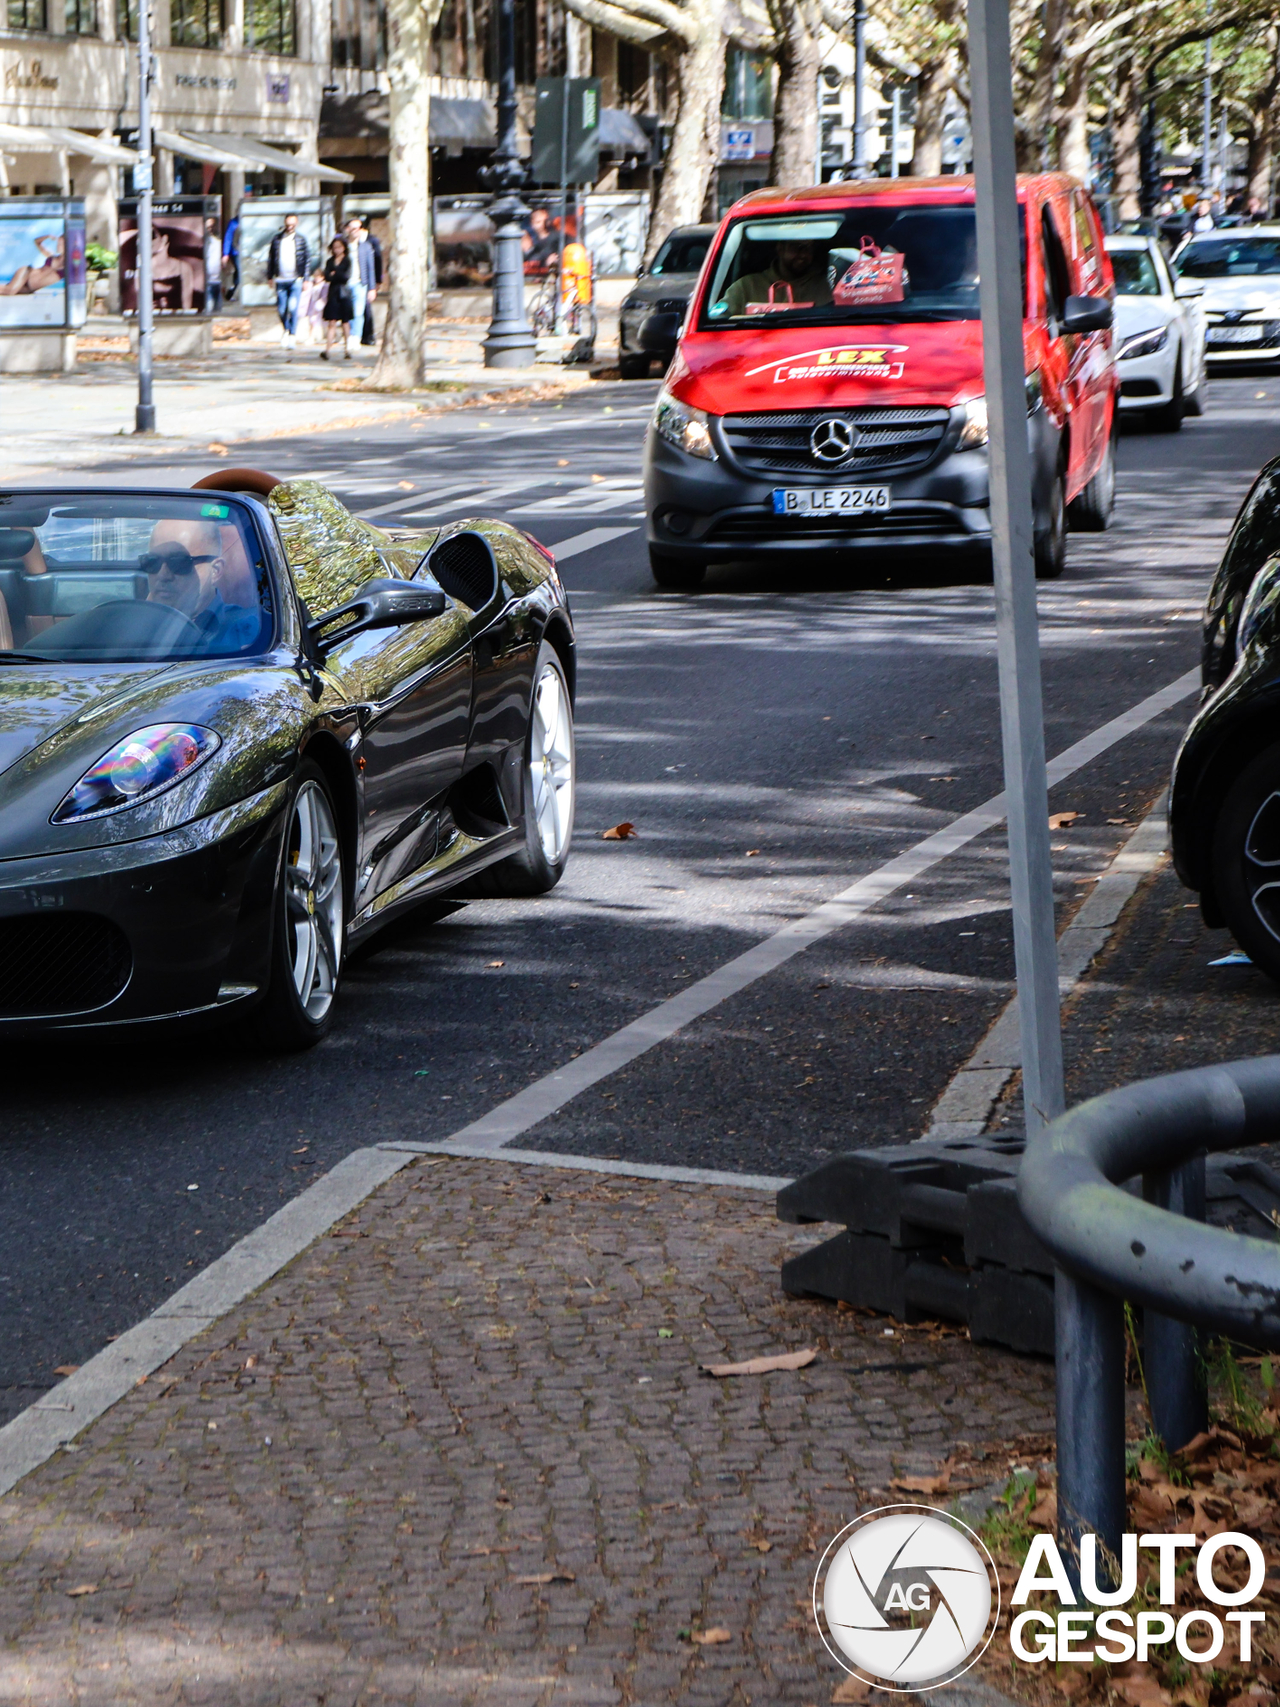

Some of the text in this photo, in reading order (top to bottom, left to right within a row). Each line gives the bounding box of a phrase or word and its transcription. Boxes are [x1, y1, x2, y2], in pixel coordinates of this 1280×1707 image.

[816, 350, 888, 365] LEX
[786, 489, 888, 510] B LE 2246
